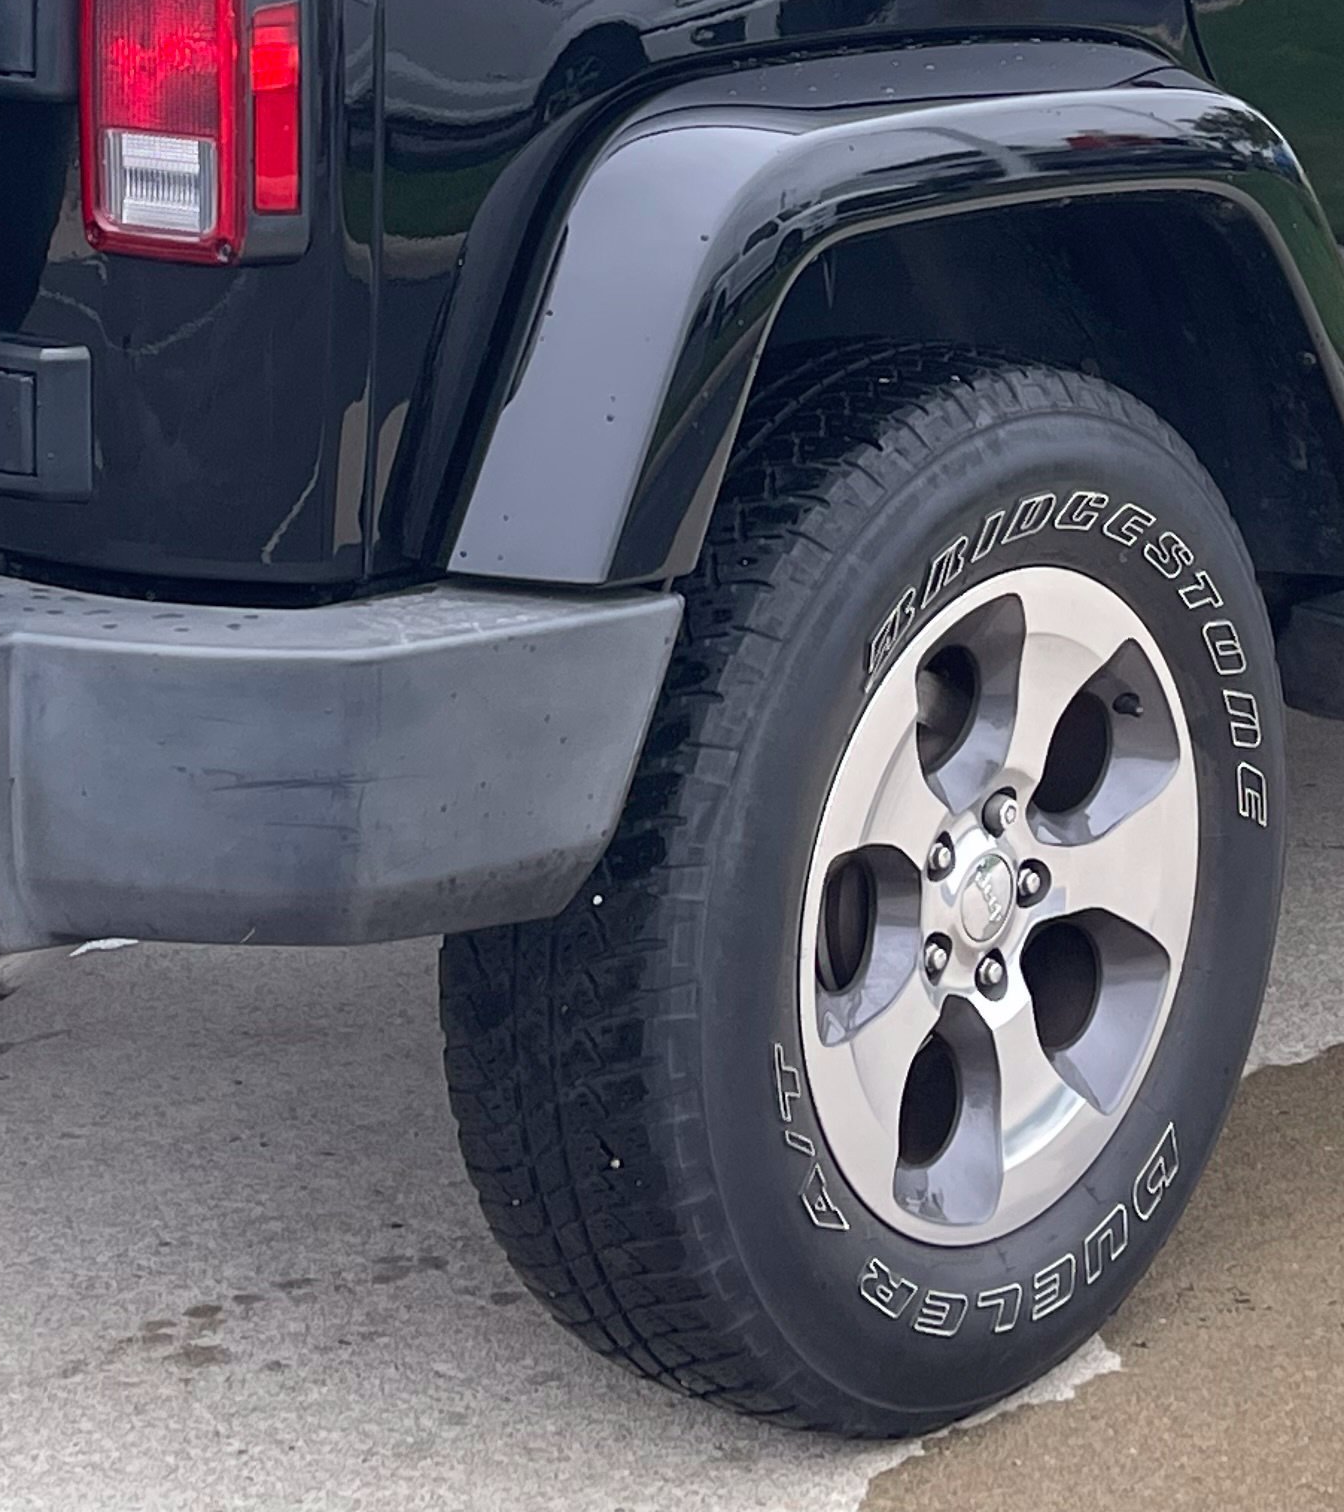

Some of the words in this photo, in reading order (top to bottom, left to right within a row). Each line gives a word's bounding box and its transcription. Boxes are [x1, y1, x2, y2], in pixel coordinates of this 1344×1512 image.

[865, 490, 1269, 828] BRIDGESTONE
[774, 1042, 851, 1231] A/T
[860, 1121, 1181, 1337] DUELER
